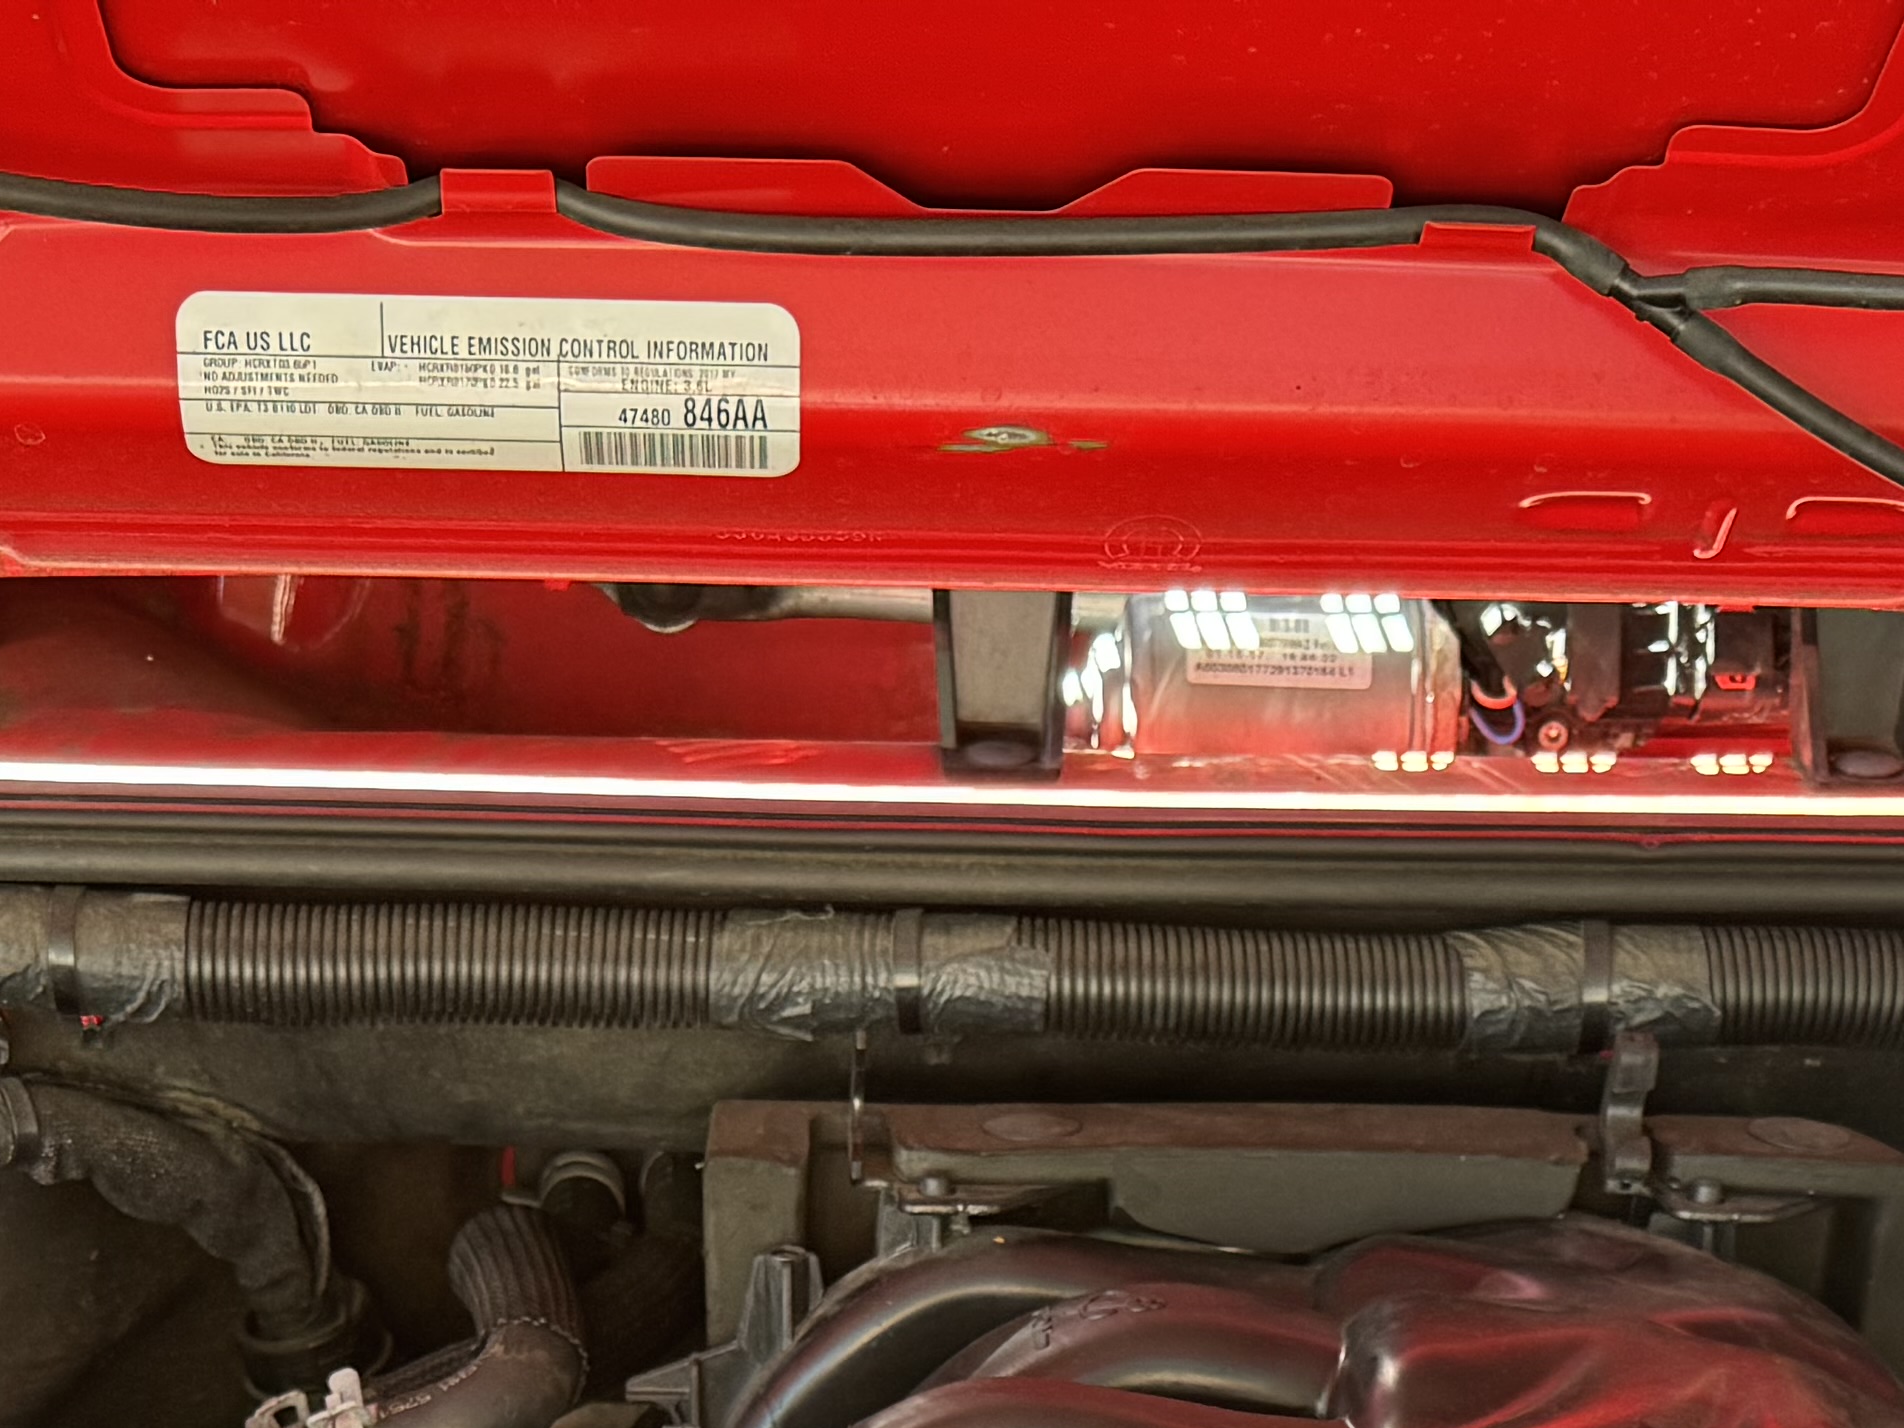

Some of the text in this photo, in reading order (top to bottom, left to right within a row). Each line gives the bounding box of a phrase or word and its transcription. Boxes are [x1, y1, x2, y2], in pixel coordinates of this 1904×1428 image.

[203, 330, 311, 353] FCA US LLC
[387, 335, 769, 362] VEHICLE EMISSION CONTROL INFORMATION
[222, 372, 295, 383] ADJUSTMENTS
[298, 373, 339, 384] NEEDED
[618, 397, 768, 429] 47480 846AA
